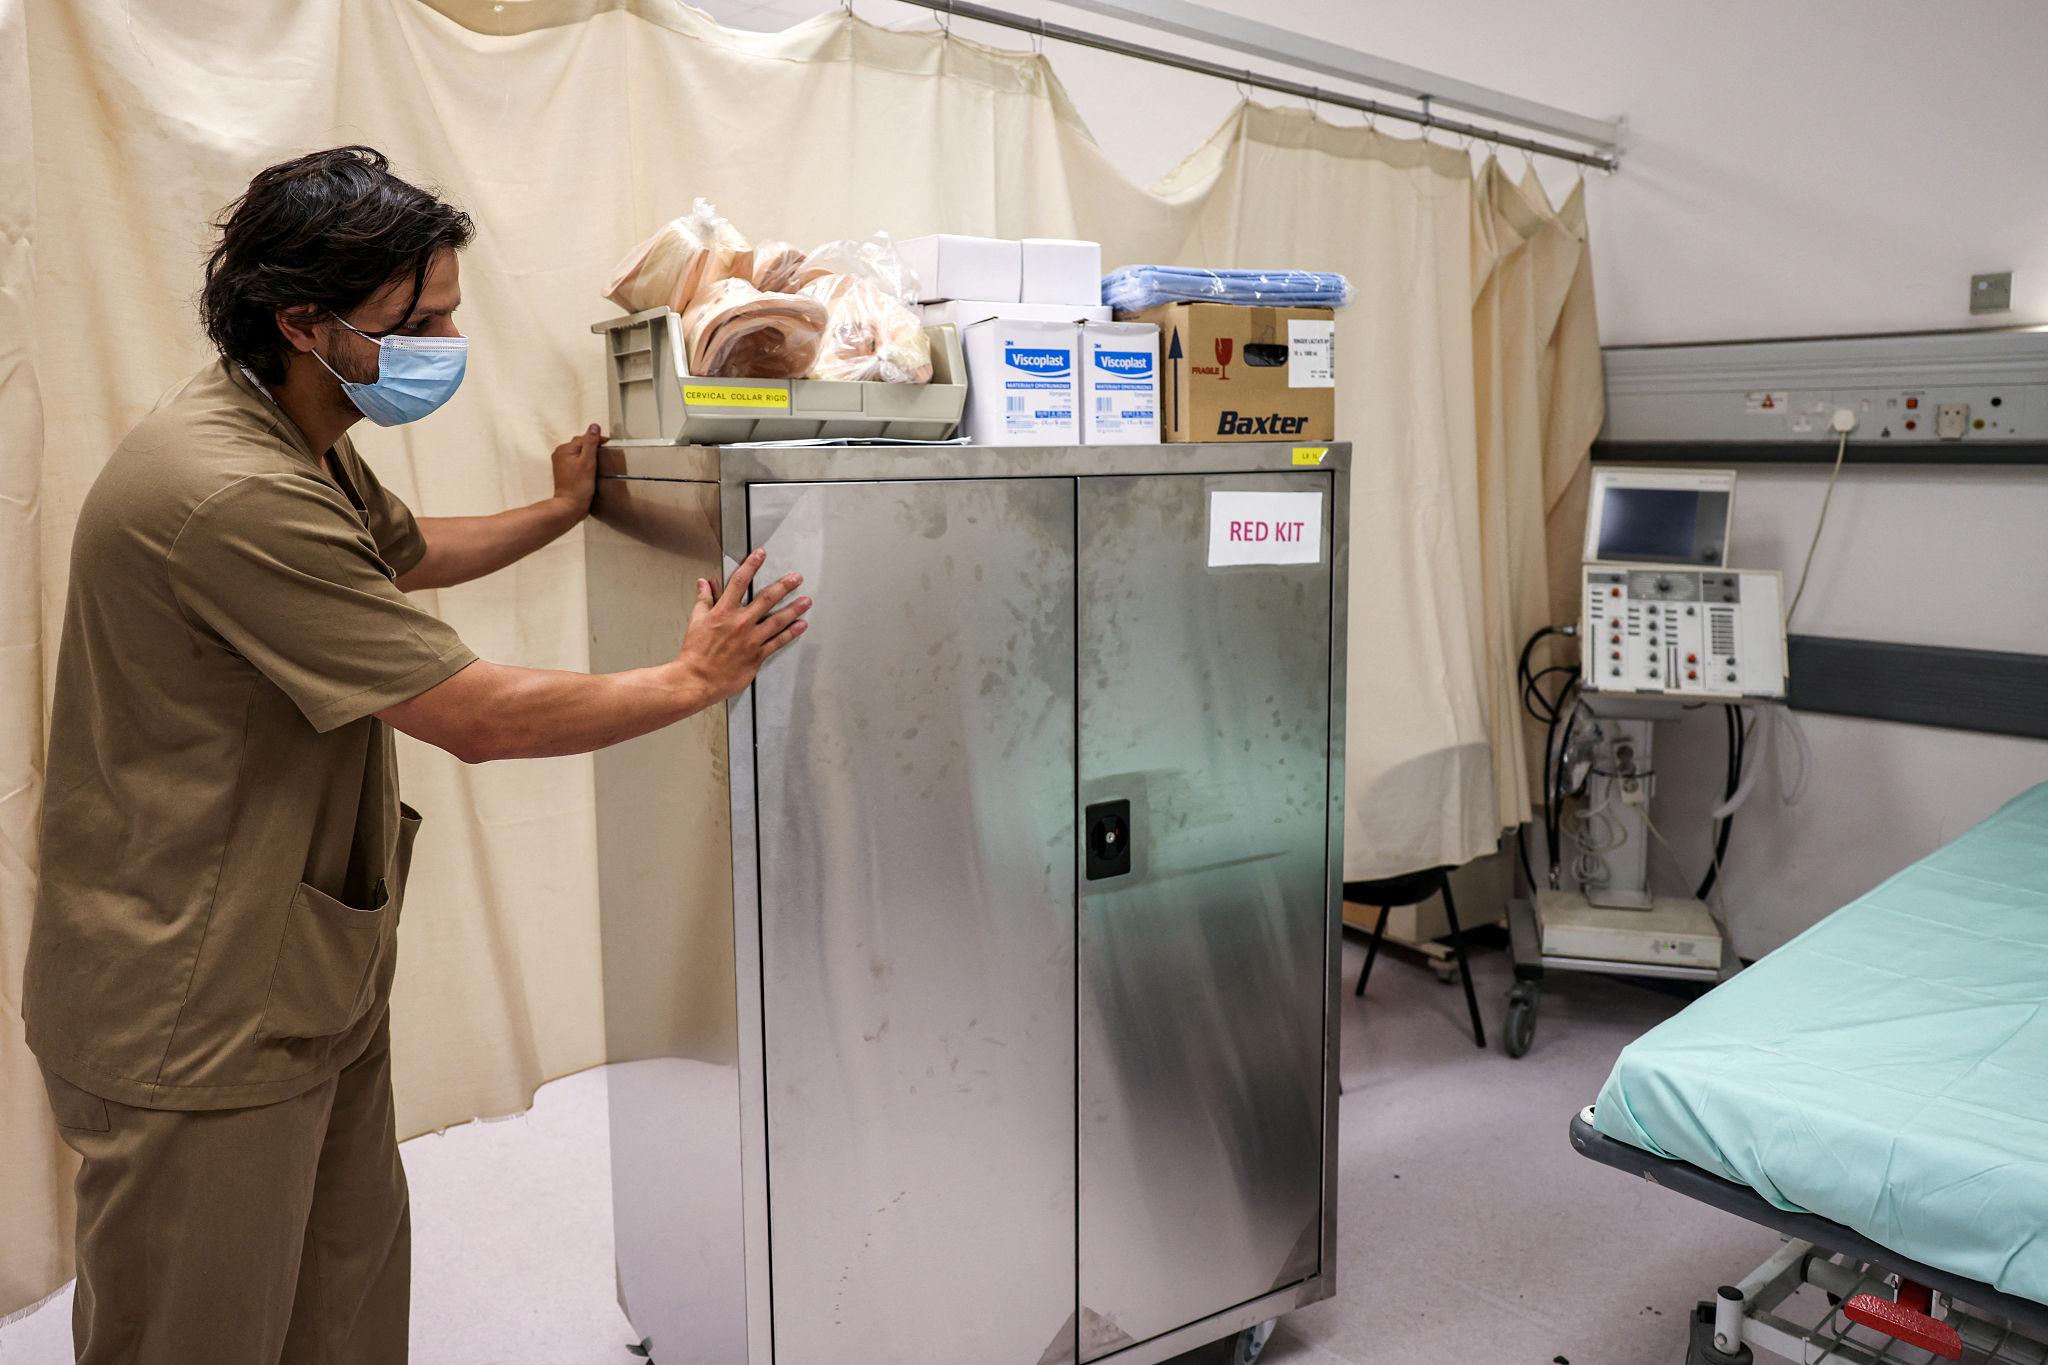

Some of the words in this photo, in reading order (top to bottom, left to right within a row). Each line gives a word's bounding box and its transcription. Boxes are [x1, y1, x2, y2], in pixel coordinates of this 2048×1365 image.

[1012, 353, 1064, 368] Viscoplast
[1100, 355, 1147, 370] Viscoplast
[1191, 366, 1220, 375] FRAGILE
[685, 391, 727, 400] CERVICAL
[730, 393, 763, 401] COLLAR
[766, 394, 788, 402] RIGID
[1217, 410, 1309, 435] Baxter
[1229, 521, 1269, 542] RED
[1275, 522, 1305, 542] KIT
